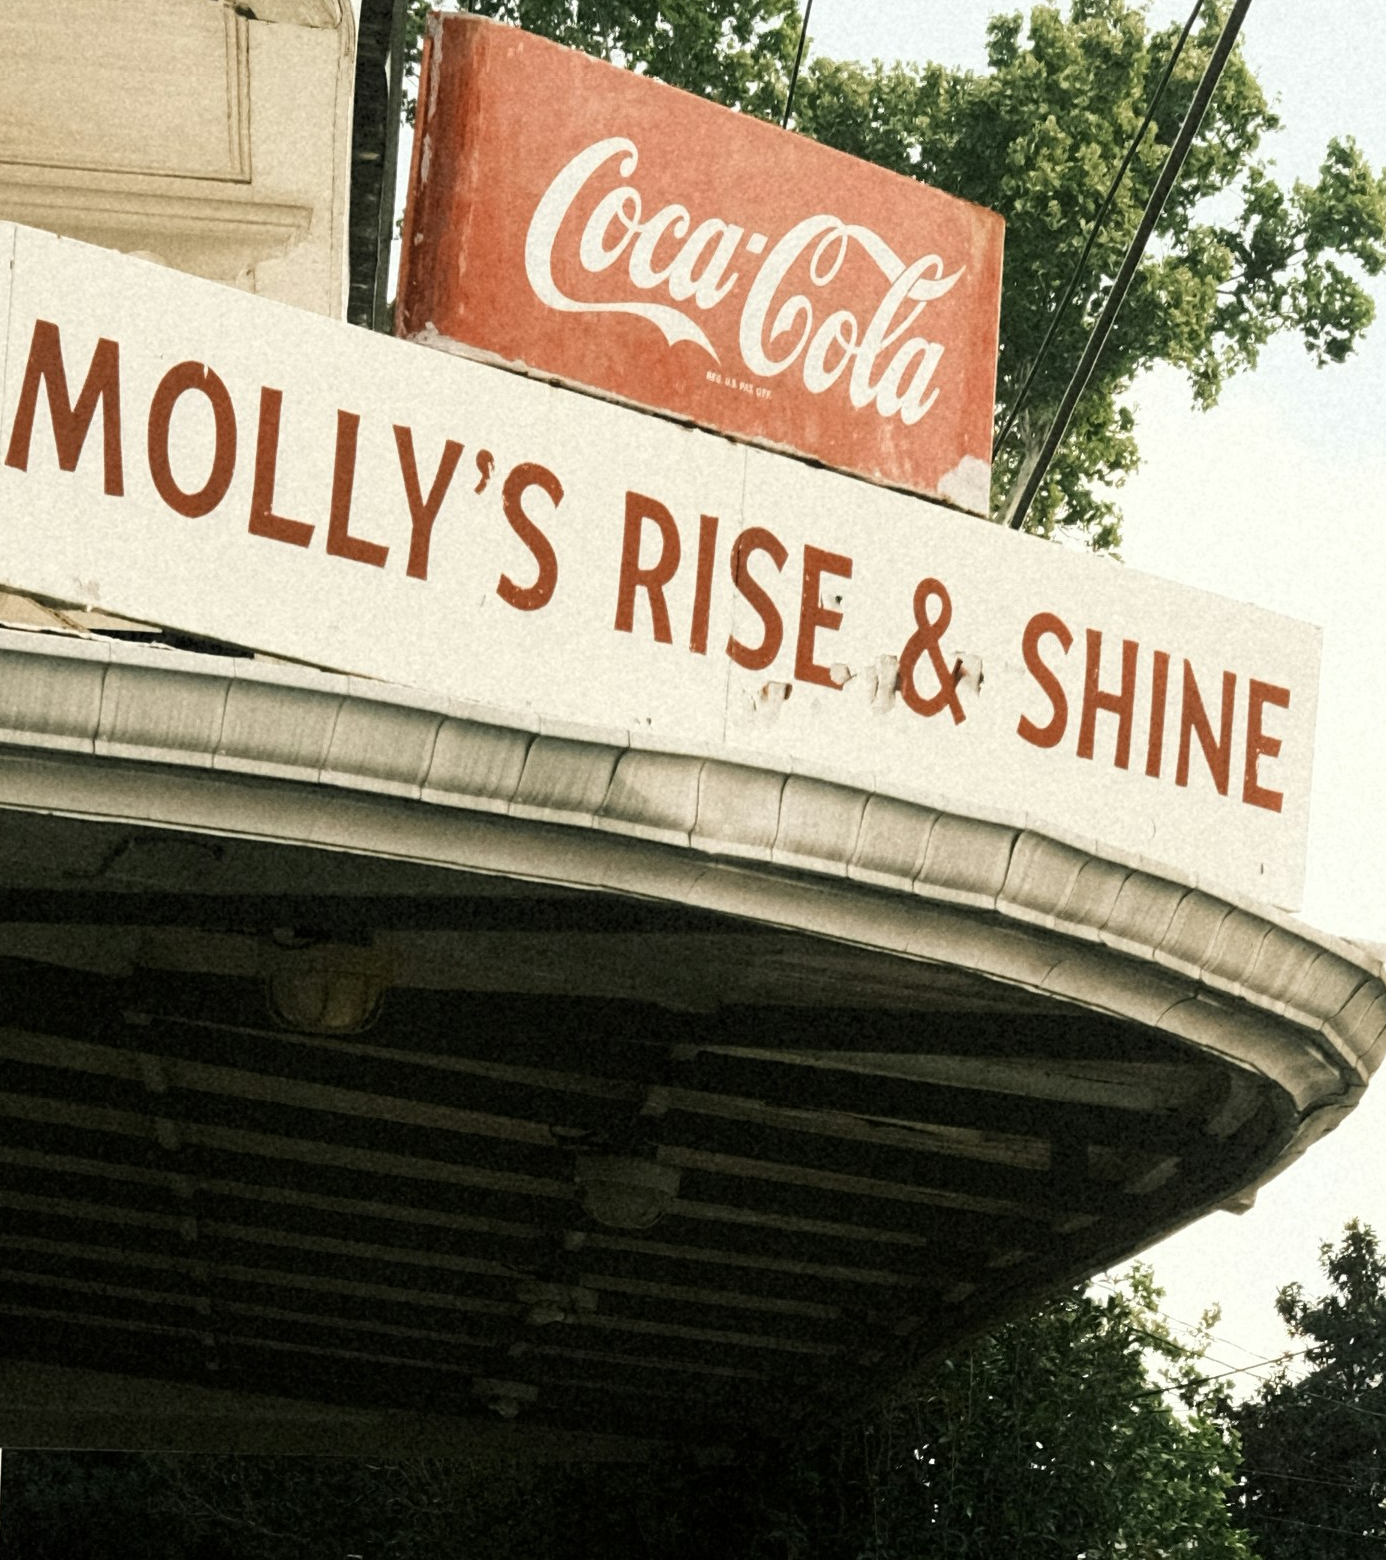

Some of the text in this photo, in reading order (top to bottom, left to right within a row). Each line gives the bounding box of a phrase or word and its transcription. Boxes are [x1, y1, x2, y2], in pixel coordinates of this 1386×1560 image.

[524, 137, 966, 426] Coca-Cola
[5, 318, 1291, 814] MOLLY'S RISE & SHINE
